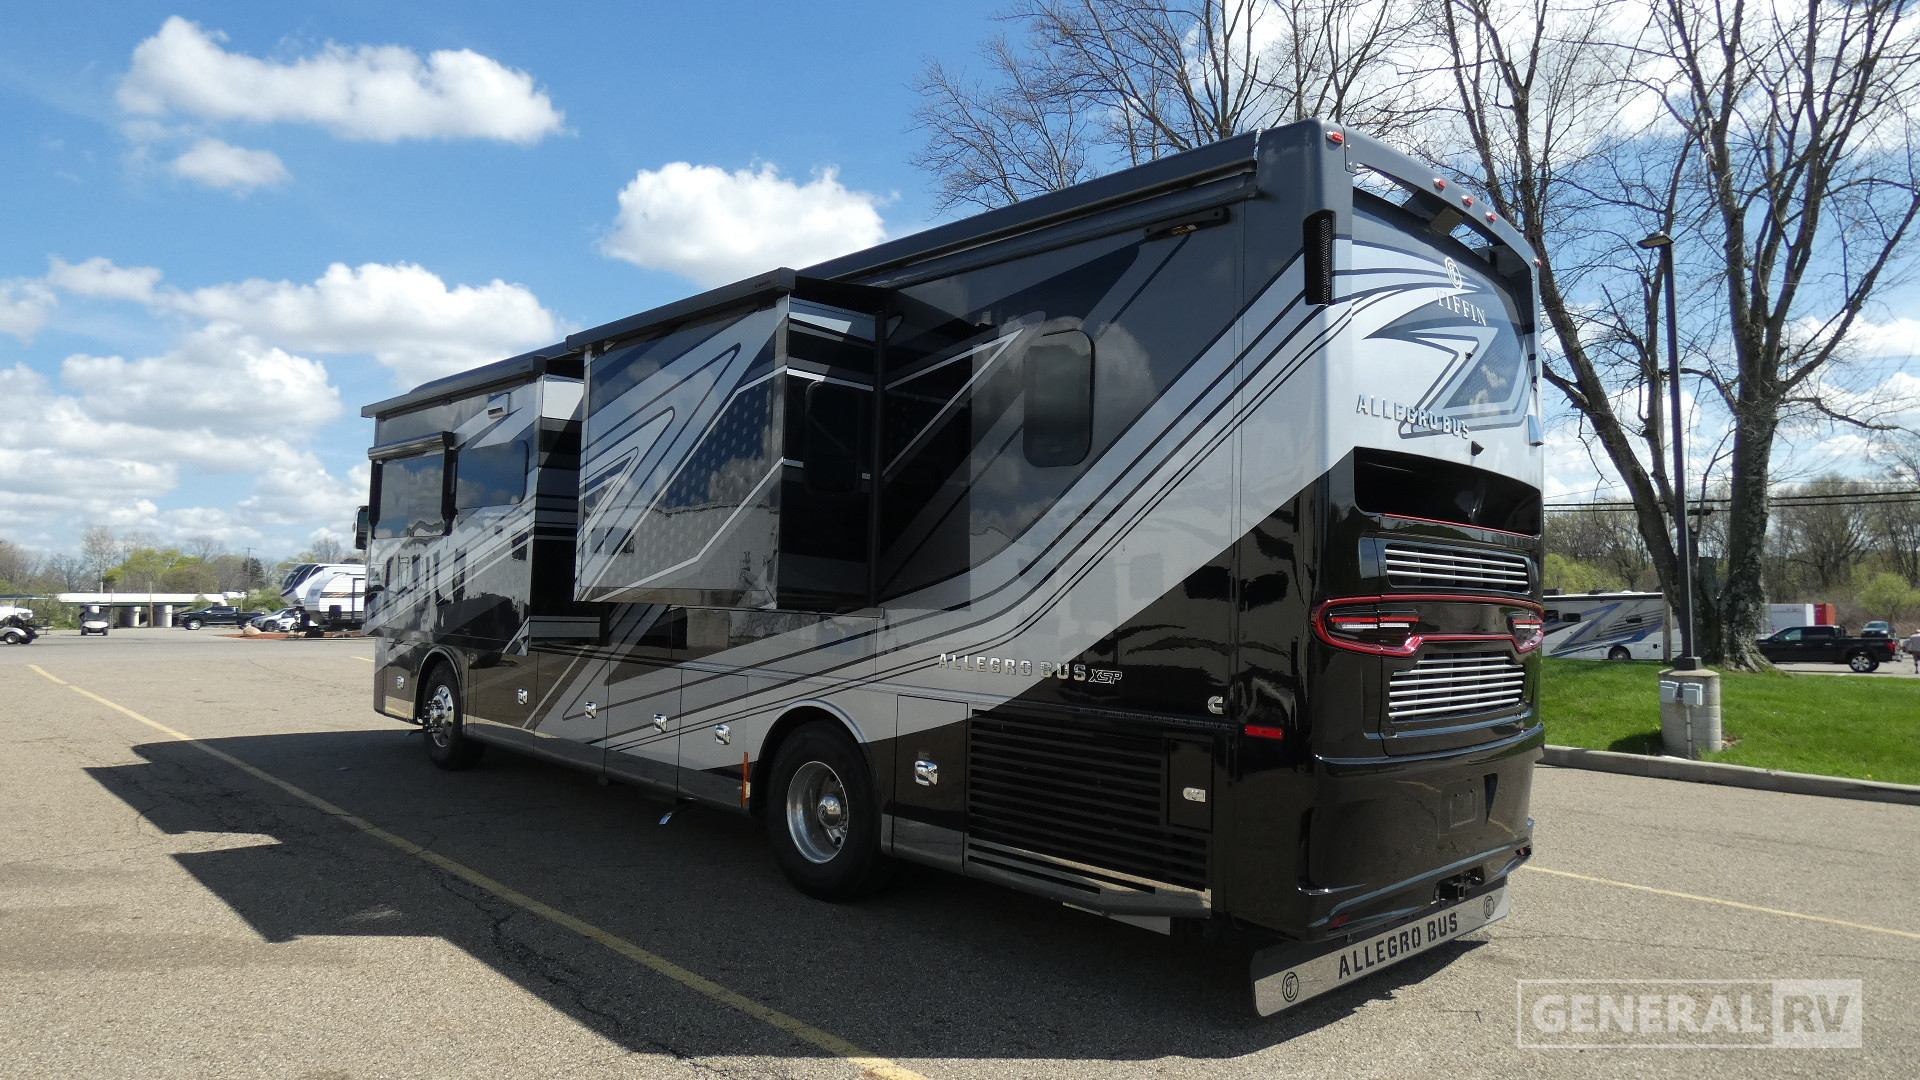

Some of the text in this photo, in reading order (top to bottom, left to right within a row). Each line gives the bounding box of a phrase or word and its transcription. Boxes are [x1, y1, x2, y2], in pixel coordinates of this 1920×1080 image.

[1432, 287, 1487, 327] TIFFIN
[1356, 394, 1469, 440] ALLEGRO BUS
[937, 653, 1123, 685] ALLEGRO BUS XSP
[1338, 912, 1458, 979] ALLEGRO BUS
